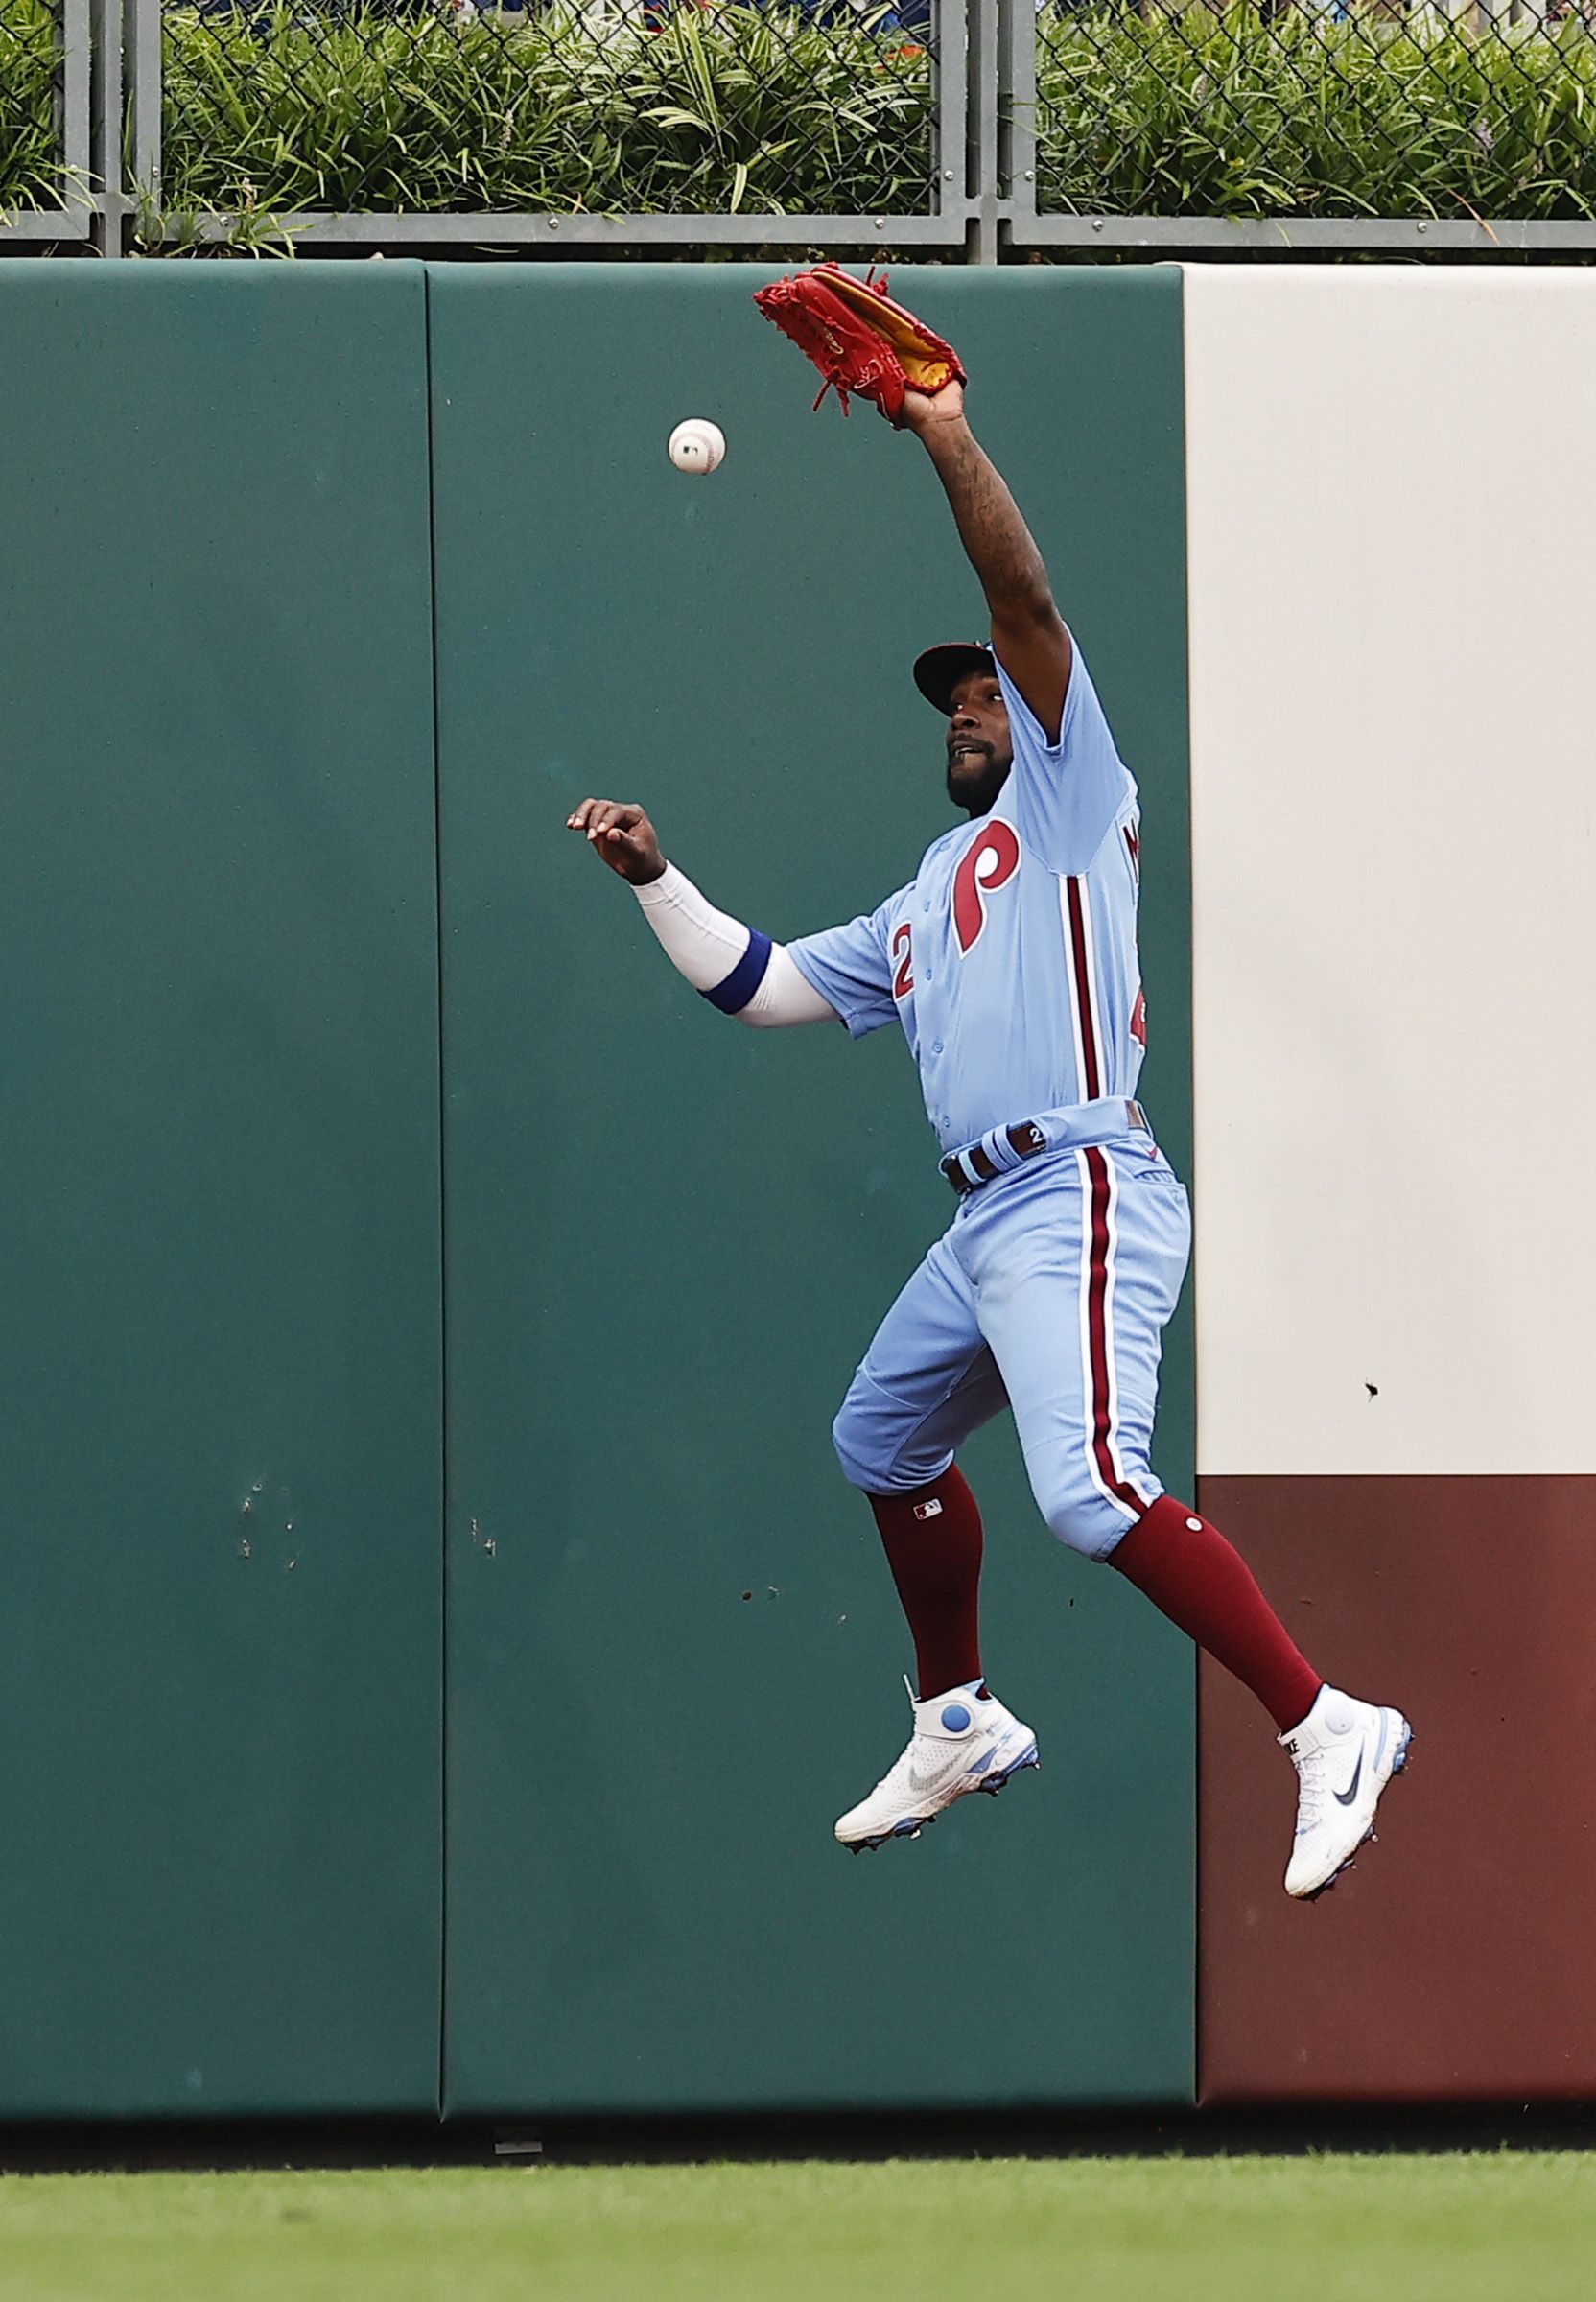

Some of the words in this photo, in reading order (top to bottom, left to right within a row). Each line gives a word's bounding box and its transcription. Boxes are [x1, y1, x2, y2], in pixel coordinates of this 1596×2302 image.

[951, 816, 1020, 958] P
[892, 921, 915, 1002] 2
[1029, 1127, 1043, 1143] 2
